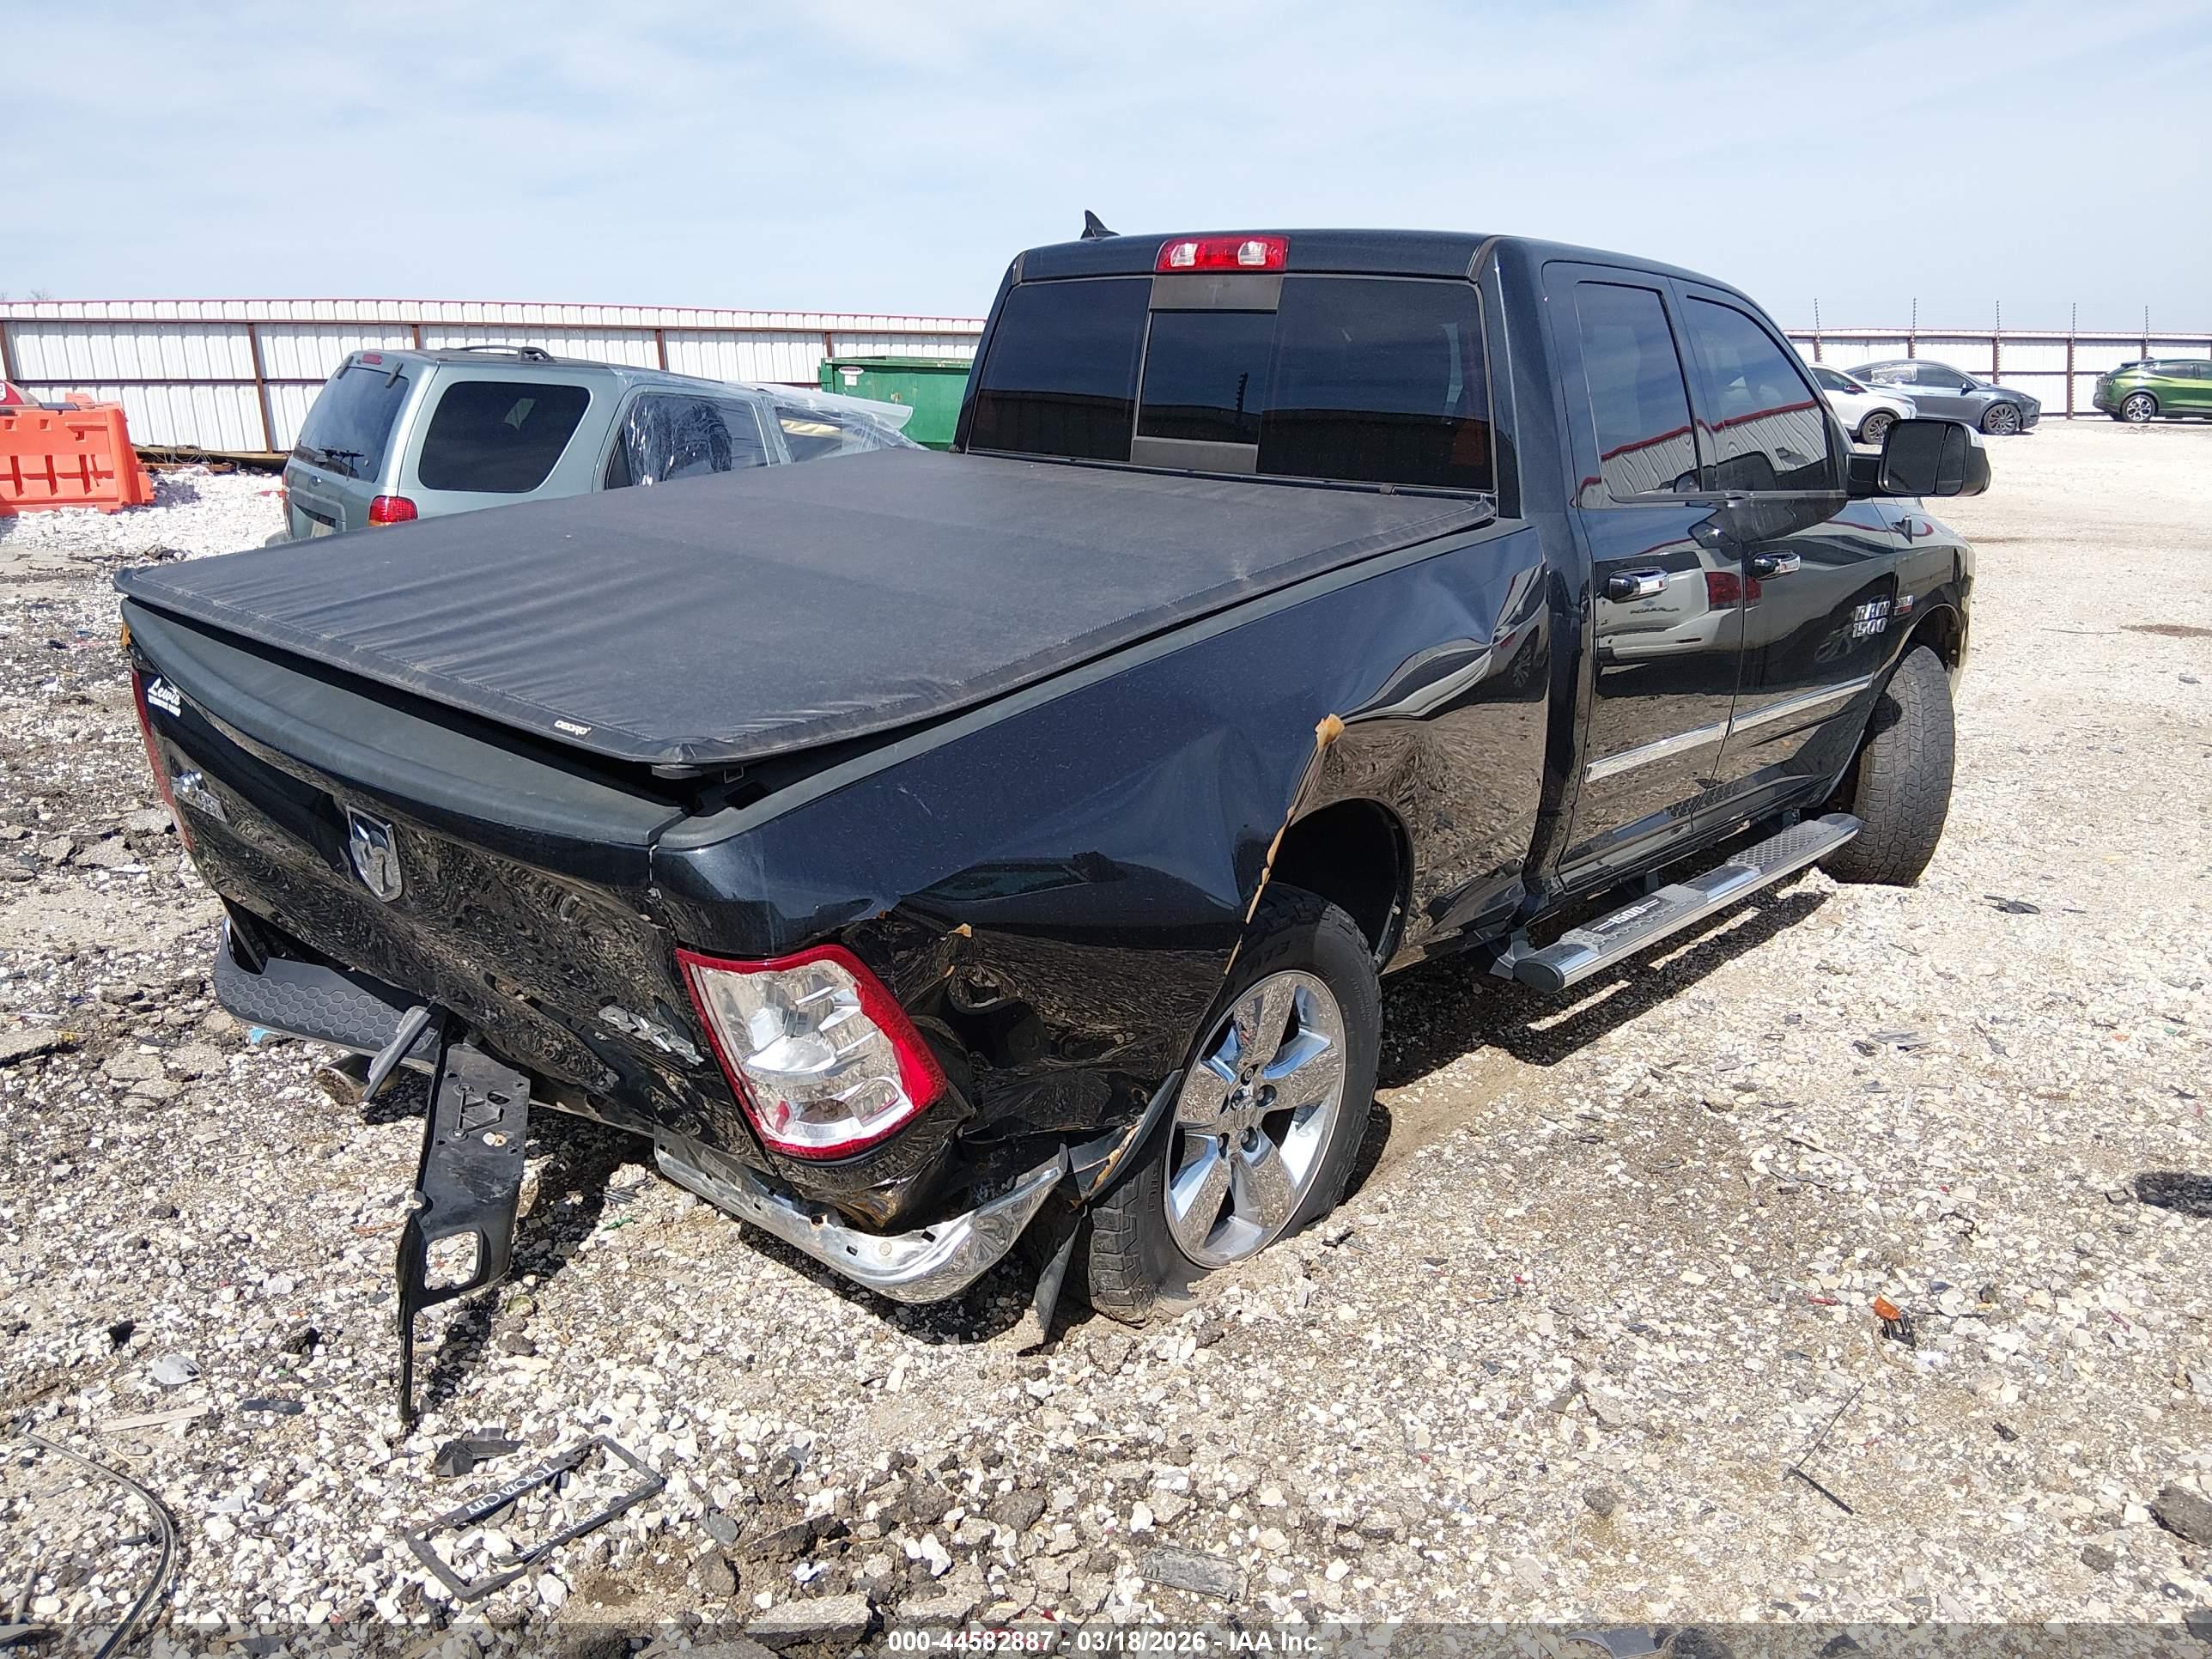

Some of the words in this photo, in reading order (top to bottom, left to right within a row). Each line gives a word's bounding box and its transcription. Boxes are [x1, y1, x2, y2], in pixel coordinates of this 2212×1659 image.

[1855, 601, 1890, 621] RAM
[1853, 618, 1887, 638] 1500
[148, 678, 180, 706] Lewis
[1608, 906, 1647, 924] 1500
[500, 1463, 559, 1496] TOYOTA
